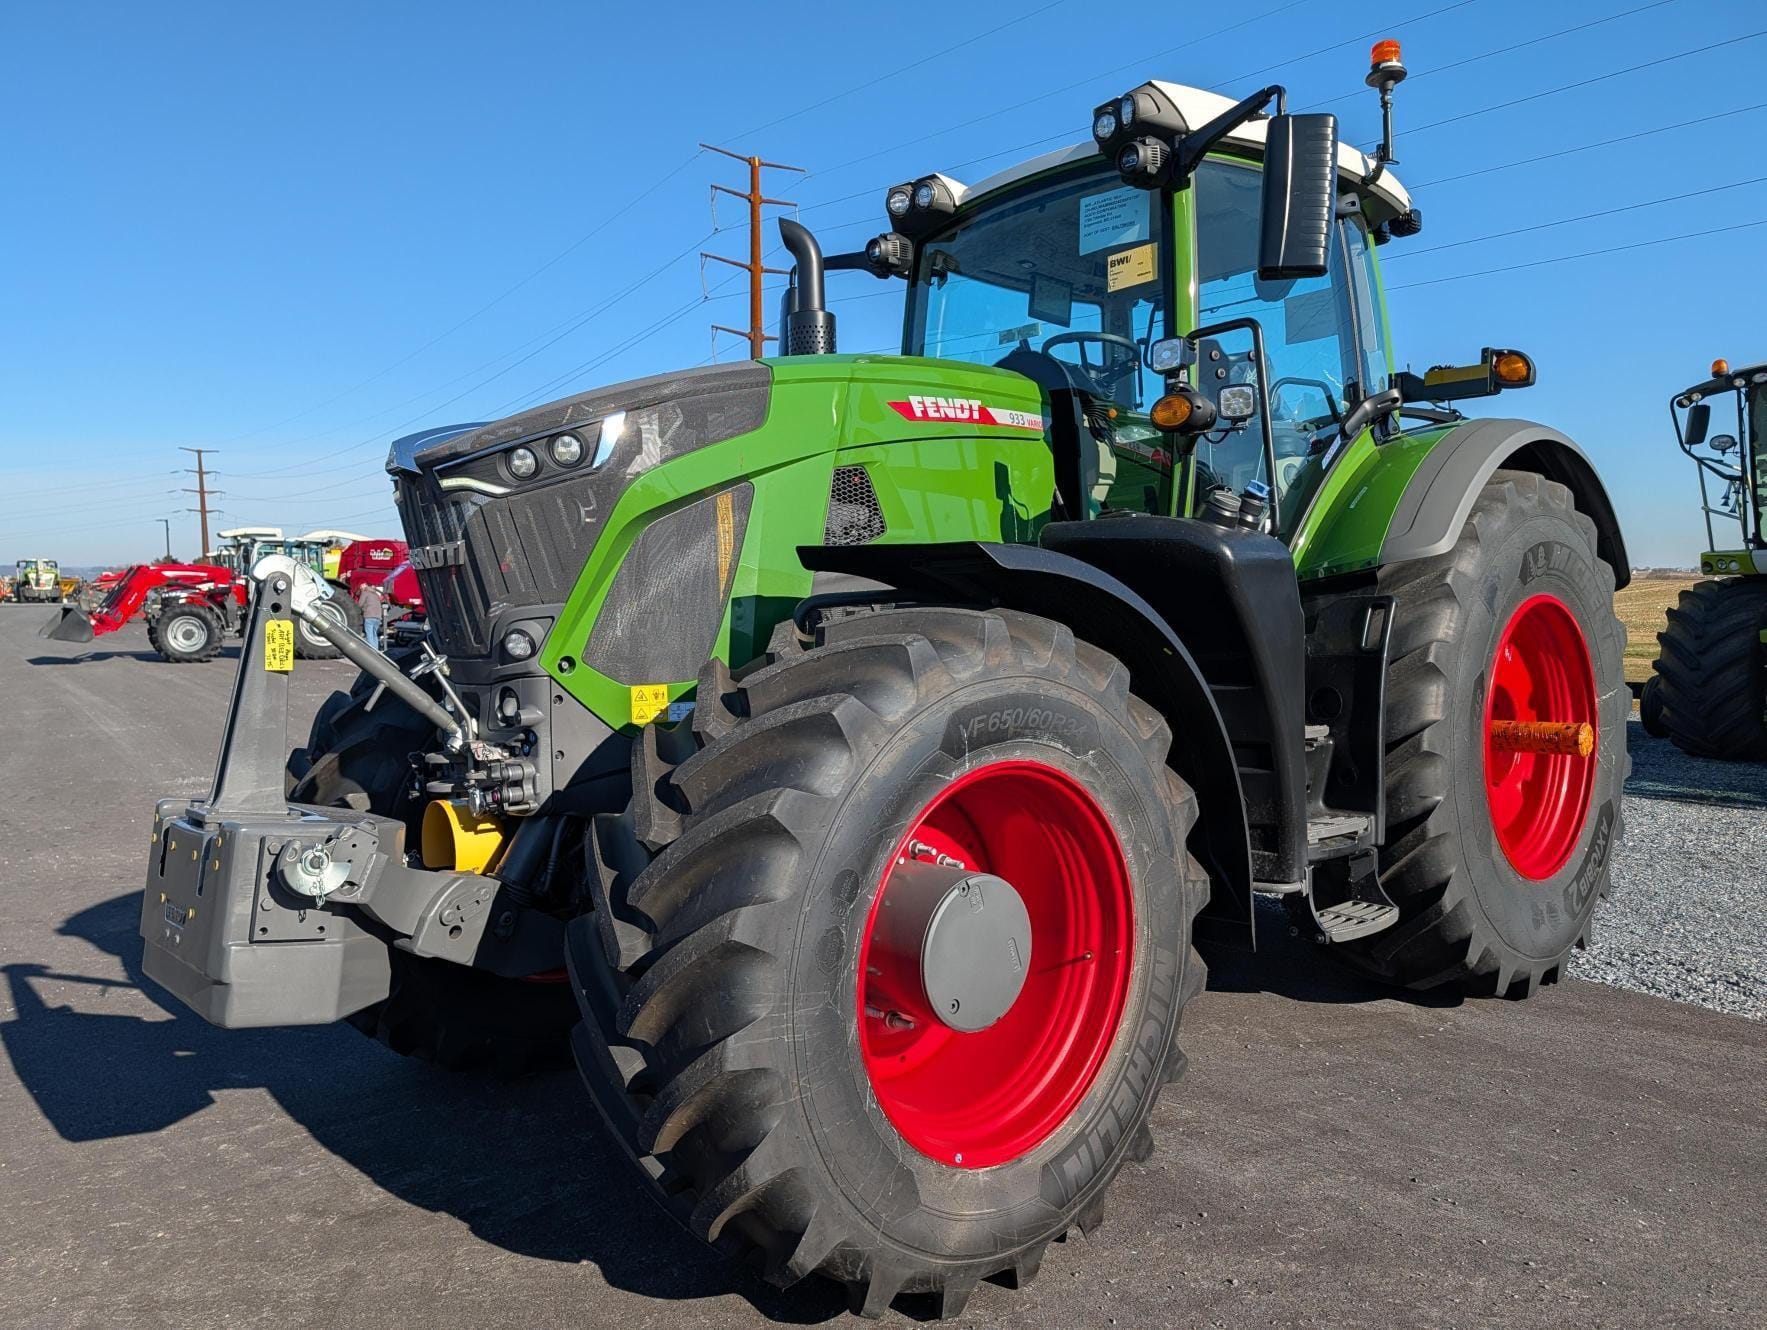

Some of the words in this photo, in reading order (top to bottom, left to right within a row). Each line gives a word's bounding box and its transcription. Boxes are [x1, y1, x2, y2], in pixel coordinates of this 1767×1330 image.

[908, 395, 981, 420] FENDT
[1009, 411, 1025, 427] 933
[1061, 944, 1177, 1198] MICHELIN
